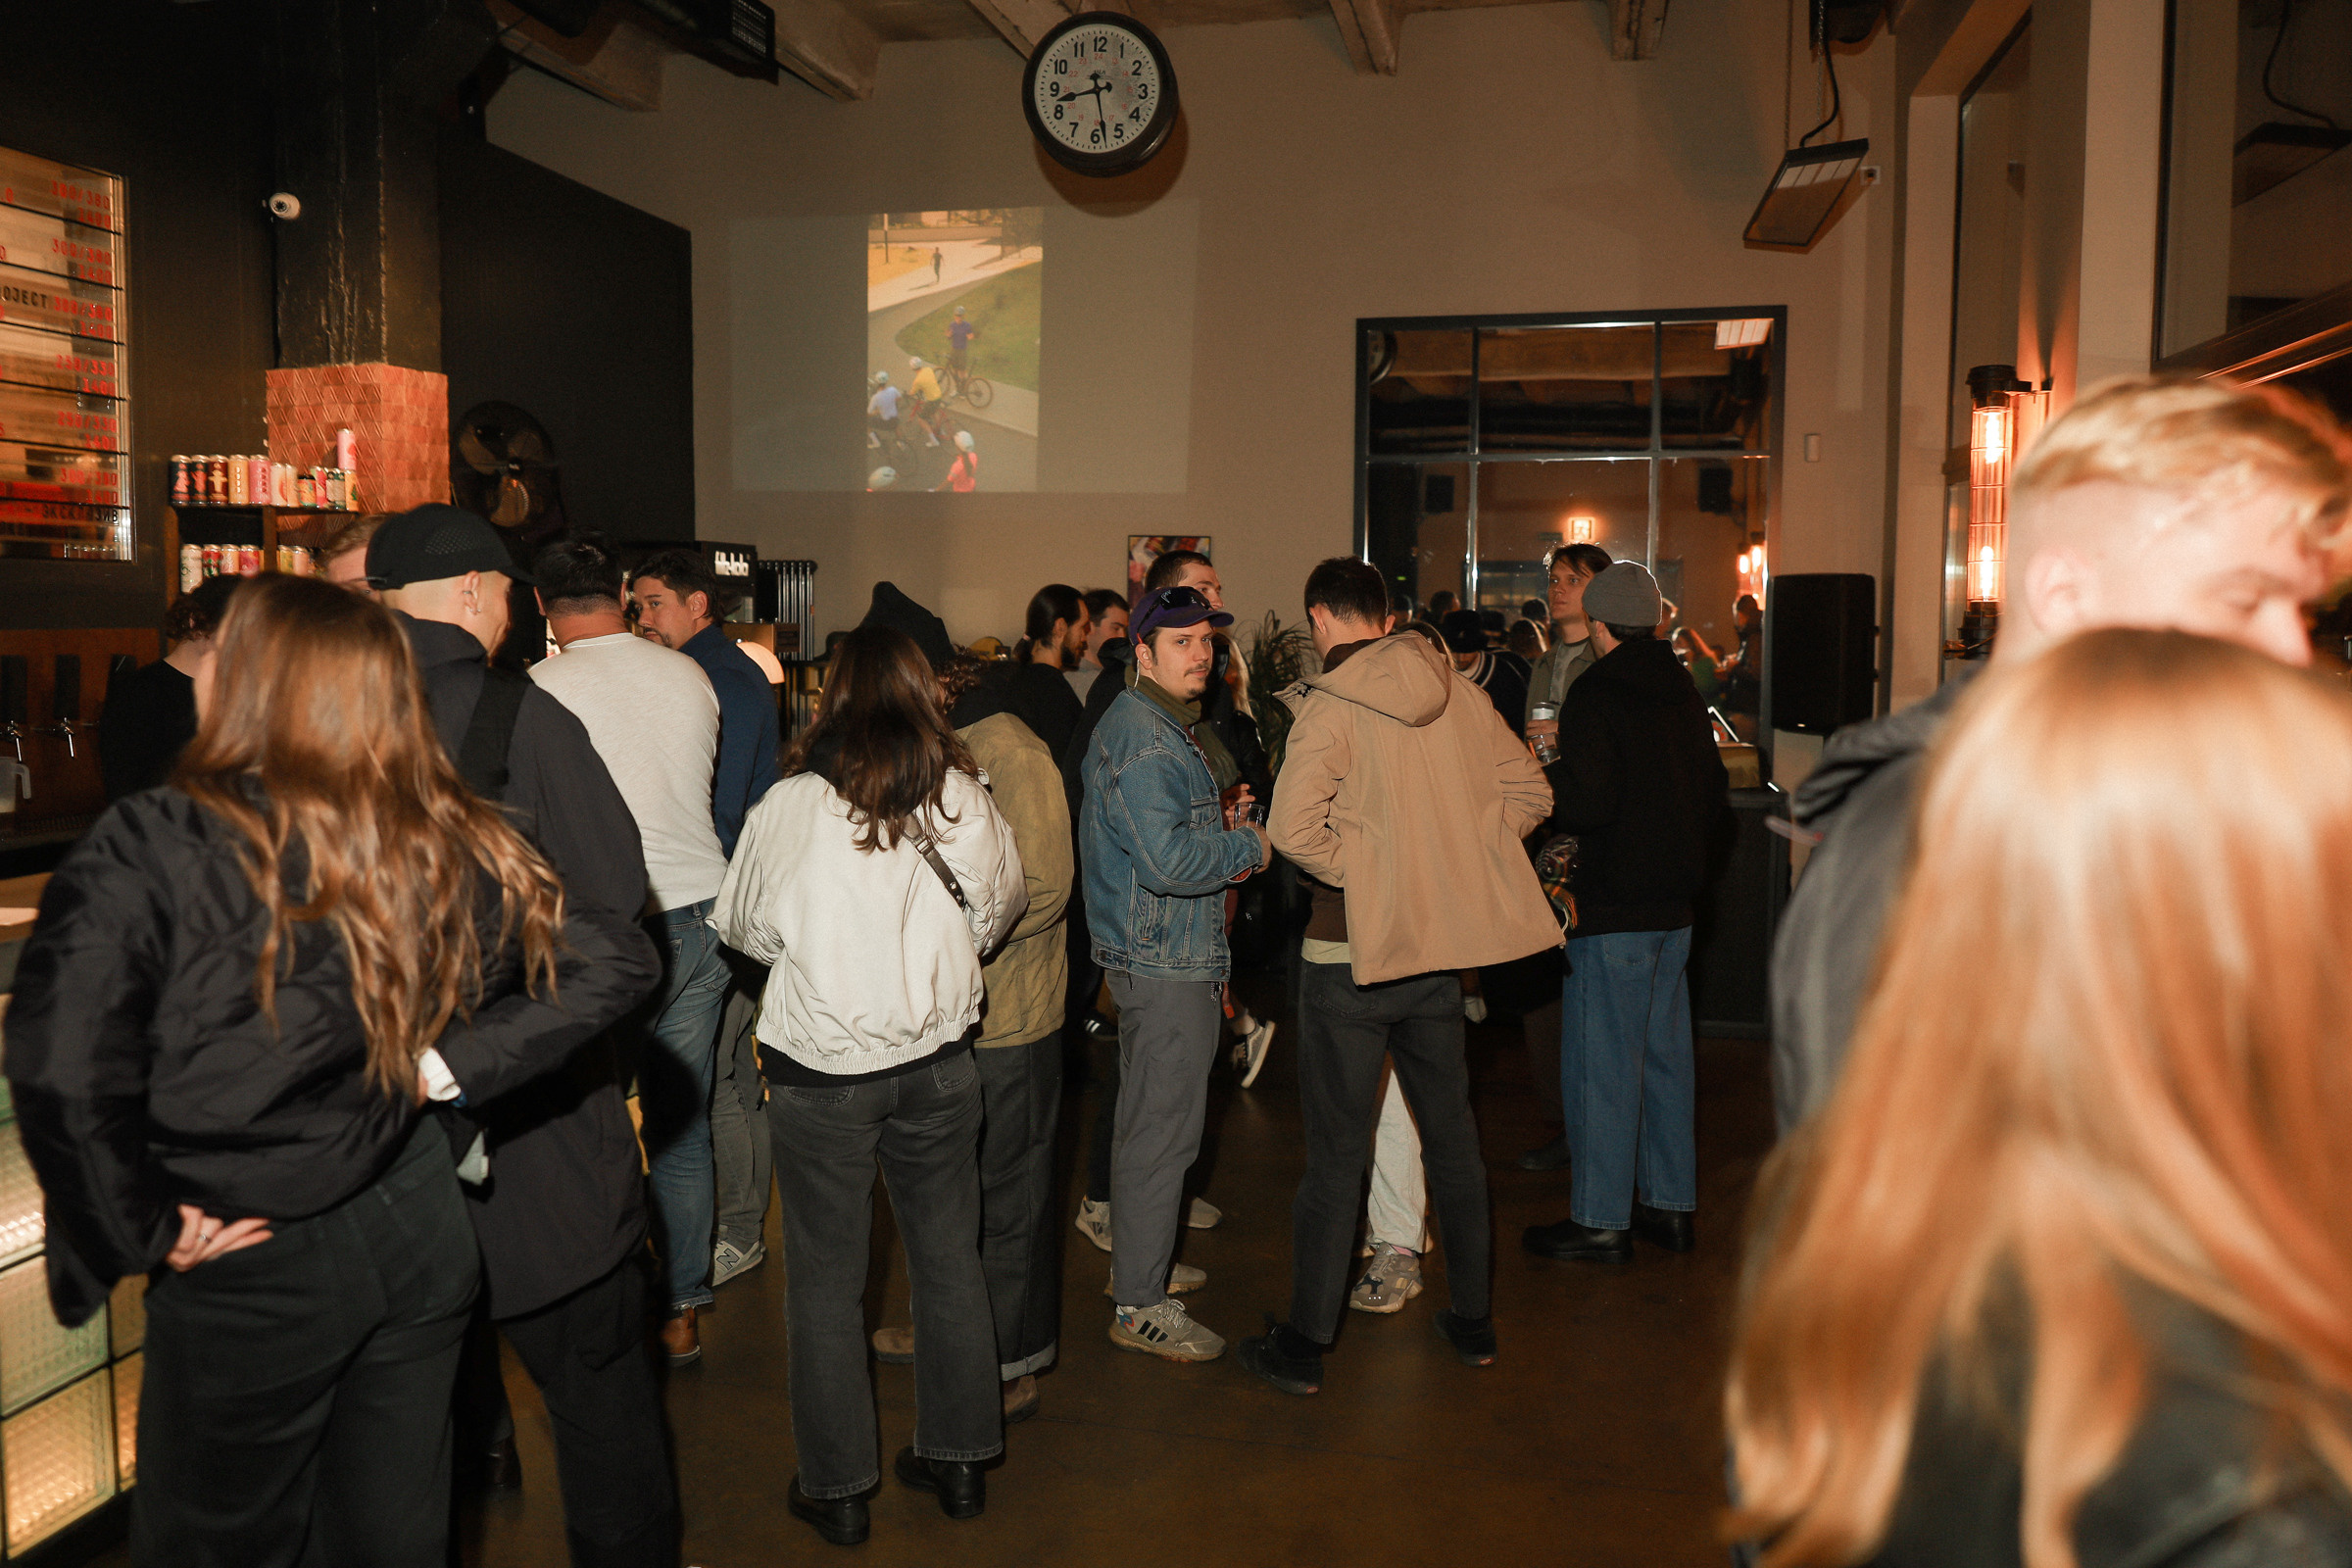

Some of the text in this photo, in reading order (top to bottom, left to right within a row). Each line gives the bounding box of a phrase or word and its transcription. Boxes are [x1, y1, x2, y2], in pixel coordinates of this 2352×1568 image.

[1074, 42, 1085, 58] 11
[1093, 36, 1107, 53] 12
[1120, 42, 1125, 59] 1
[1054, 59, 1068, 74] 10
[1132, 60, 1143, 76] 2
[1050, 81, 1060, 98] 9
[1138, 83, 1149, 100] 3
[1054, 104, 1064, 121] 8
[1129, 107, 1141, 122] 4
[1069, 122, 1079, 138] 7
[1090, 128, 1101, 144] 6
[1113, 123, 1124, 139] 5
[78, 207, 112, 229] 1400
[52, 238, 112, 266] 300/380
[78, 264, 112, 284] 1400
[80, 320, 114, 339] 1400
[82, 377, 116, 397] 1400
